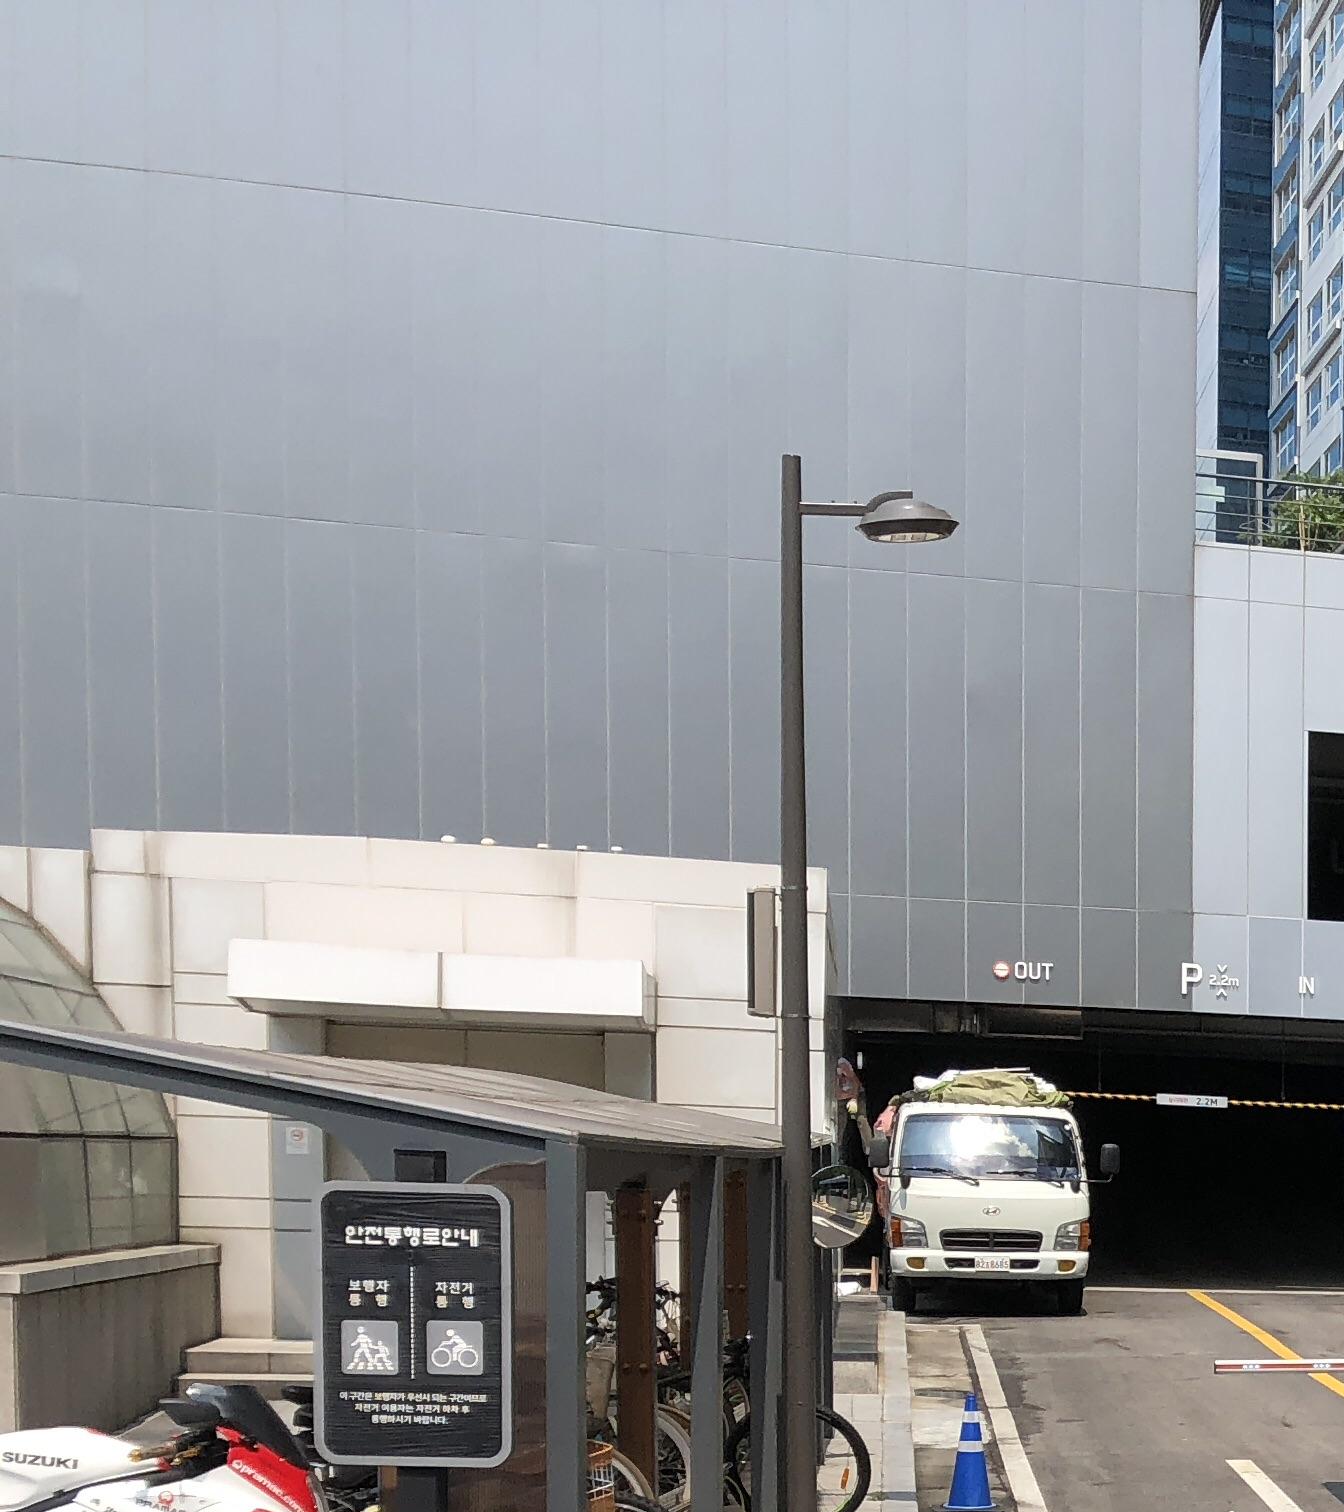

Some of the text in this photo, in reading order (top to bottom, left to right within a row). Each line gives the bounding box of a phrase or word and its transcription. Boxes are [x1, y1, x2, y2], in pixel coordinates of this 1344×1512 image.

[1013, 962, 1054, 982] OUT
[1181, 962, 1240, 995] P 2.2m
[1298, 976, 1315, 995] IN
[344, 1225, 480, 1248] 안전통행로안내
[348, 1279, 391, 1293] 보행자
[434, 1281, 475, 1295] 자전거
[1, 1452, 79, 1470] SUZUKI
